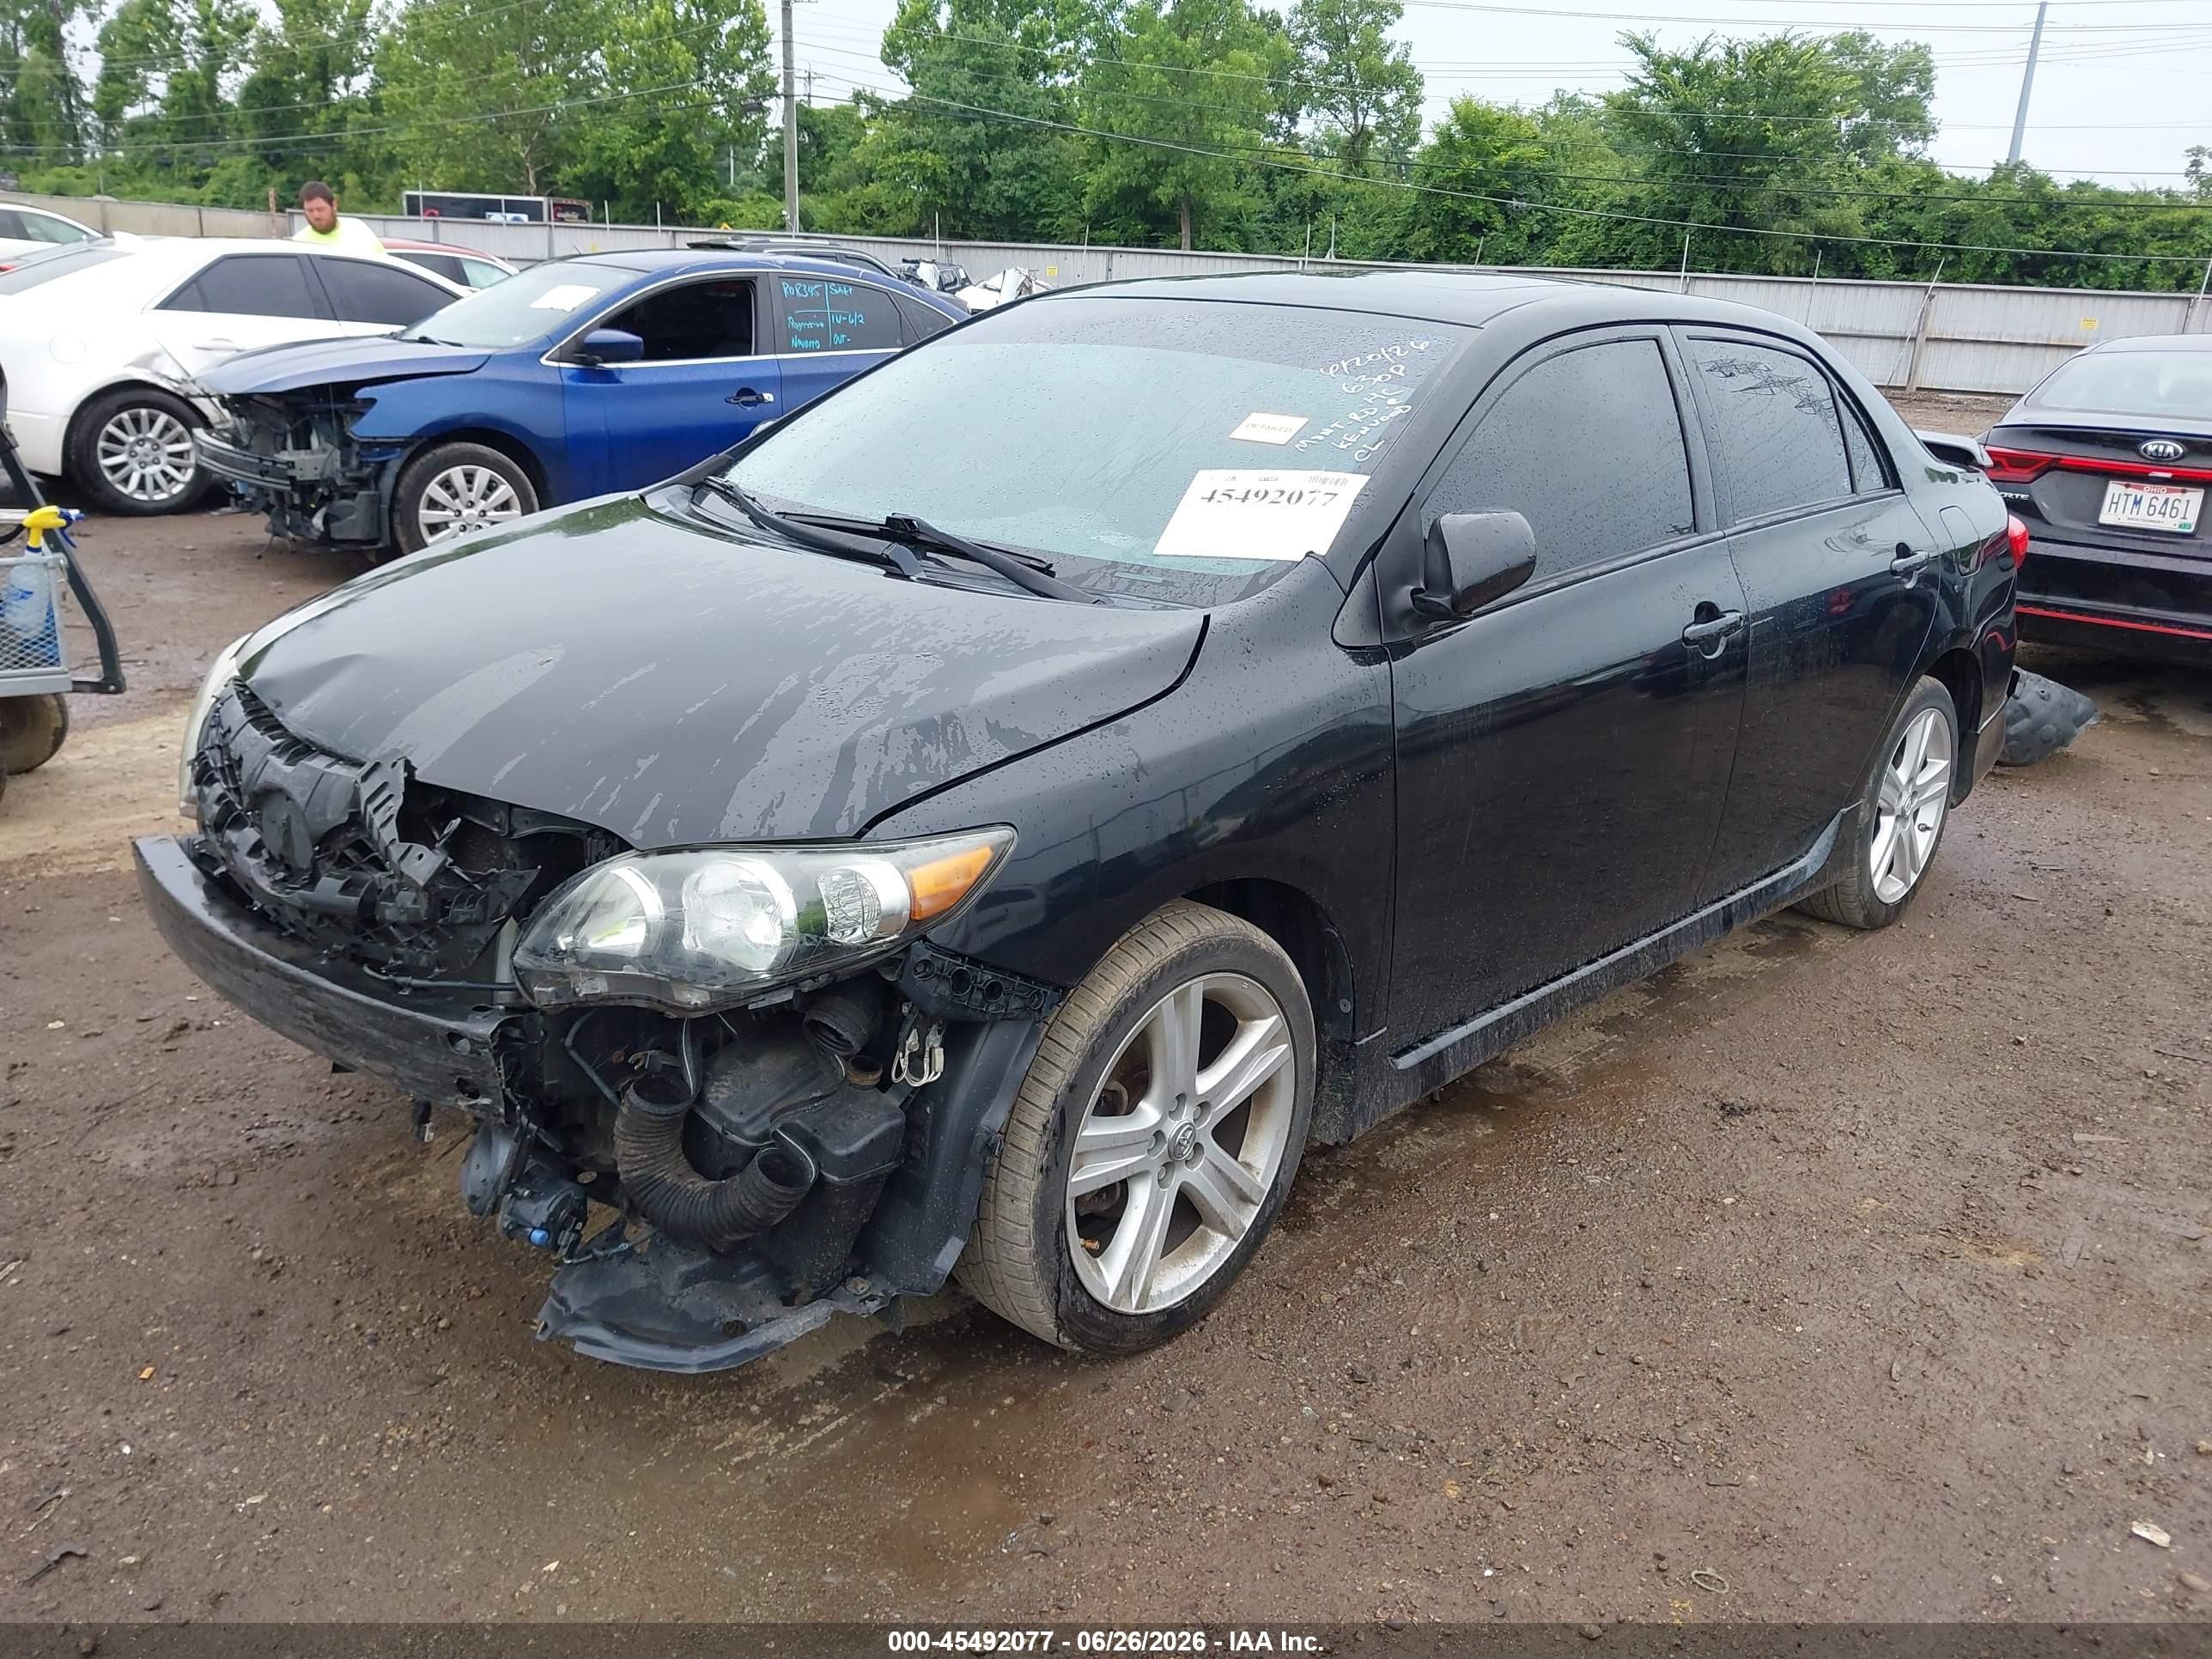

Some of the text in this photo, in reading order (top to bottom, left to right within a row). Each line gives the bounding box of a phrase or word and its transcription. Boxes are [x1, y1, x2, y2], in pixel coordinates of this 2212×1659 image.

[2147, 443, 2175, 458] KIA
[1200, 488, 1339, 507] 45492077
[1999, 491, 2030, 501] ORTE
[2108, 492, 2191, 520] HTM 6461
